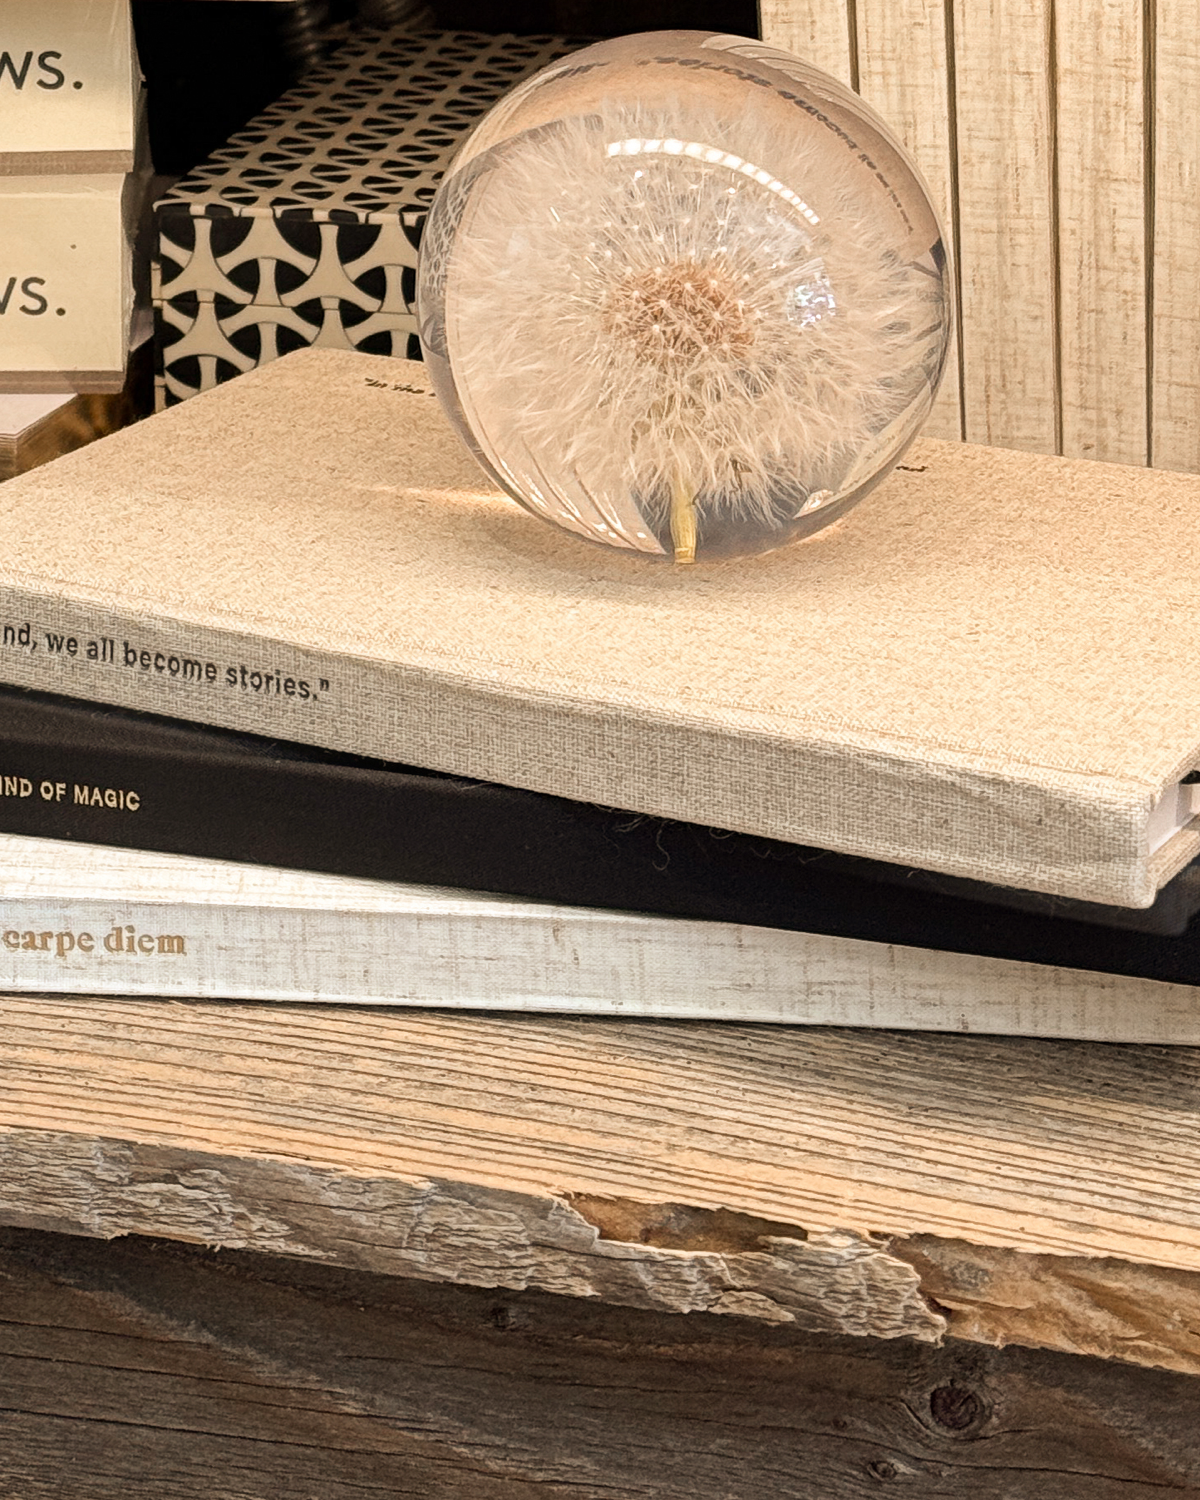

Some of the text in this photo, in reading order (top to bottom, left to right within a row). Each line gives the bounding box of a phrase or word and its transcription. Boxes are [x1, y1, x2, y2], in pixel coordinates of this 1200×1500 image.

[45, 632, 78, 656] we
[86, 637, 115, 662] all
[123, 641, 217, 681] become
[225, 664, 330, 701] stories."
[40, 780, 66, 802] OF
[73, 784, 141, 811] MAGIC
[2, 924, 188, 958] carpe diem
